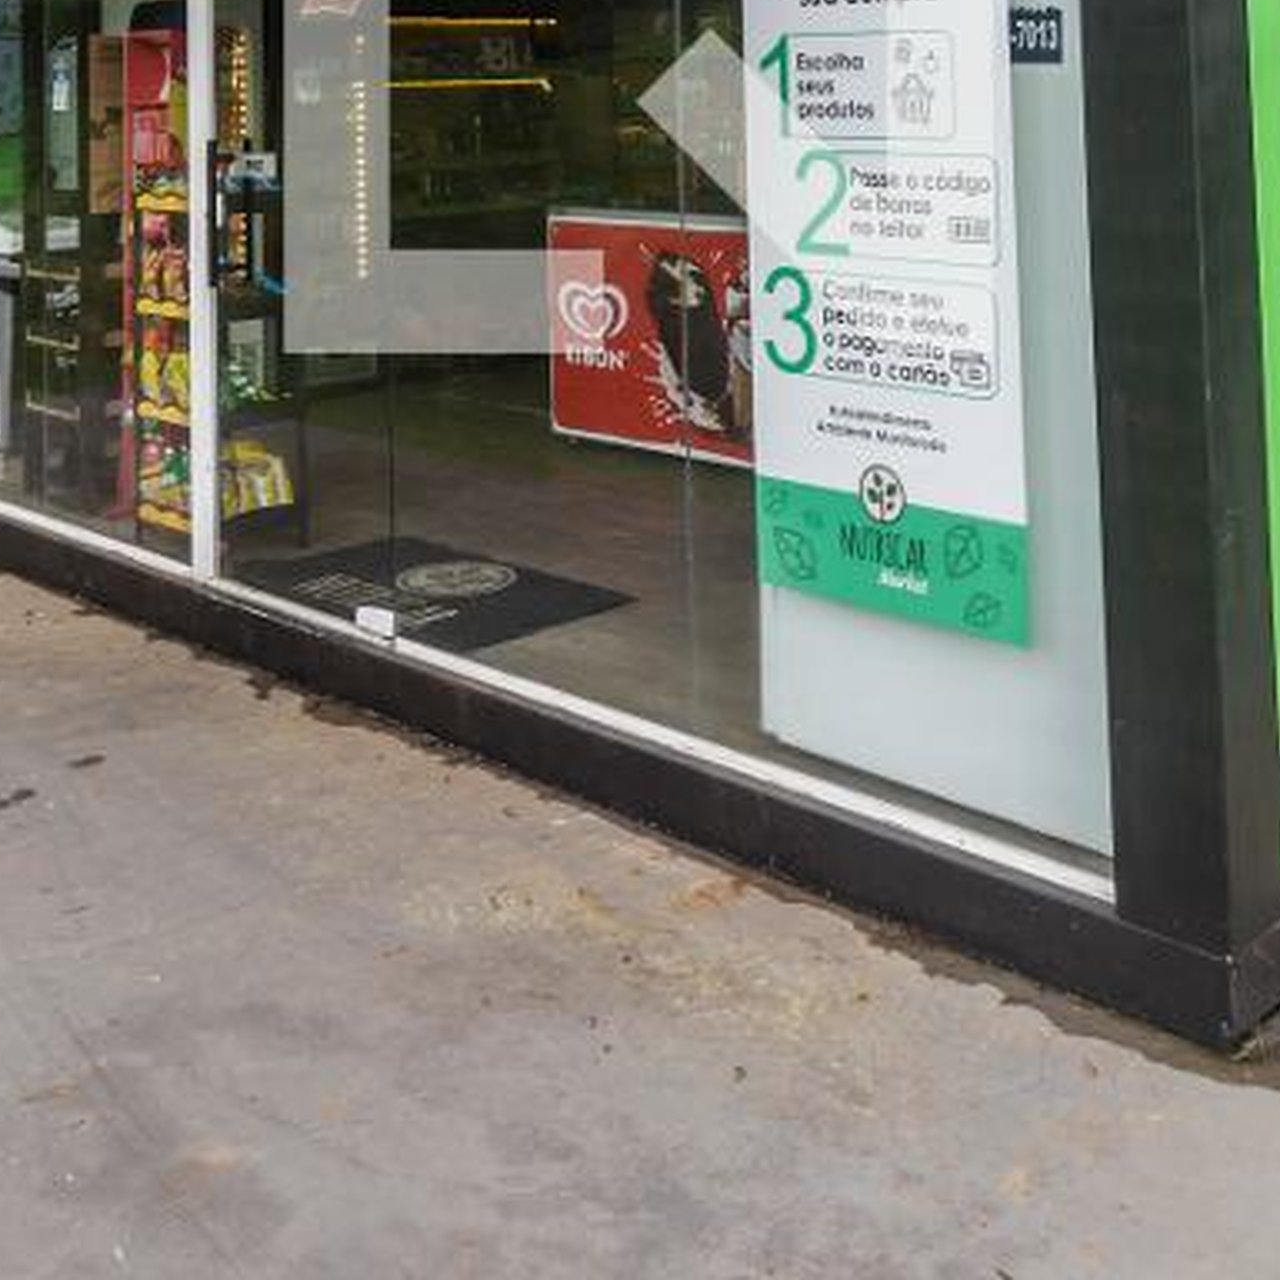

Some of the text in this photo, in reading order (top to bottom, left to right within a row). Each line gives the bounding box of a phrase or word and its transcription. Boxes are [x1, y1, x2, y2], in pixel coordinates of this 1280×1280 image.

[795, 52, 865, 71] Escolha
[758, 34, 790, 137] 1
[796, 80, 835, 95] seus
[797, 100, 875, 120] produtos
[850, 166, 900, 188] Passe
[796, 149, 851, 257] 2
[764, 266, 817, 374] 3
[823, 355, 865, 373] com
